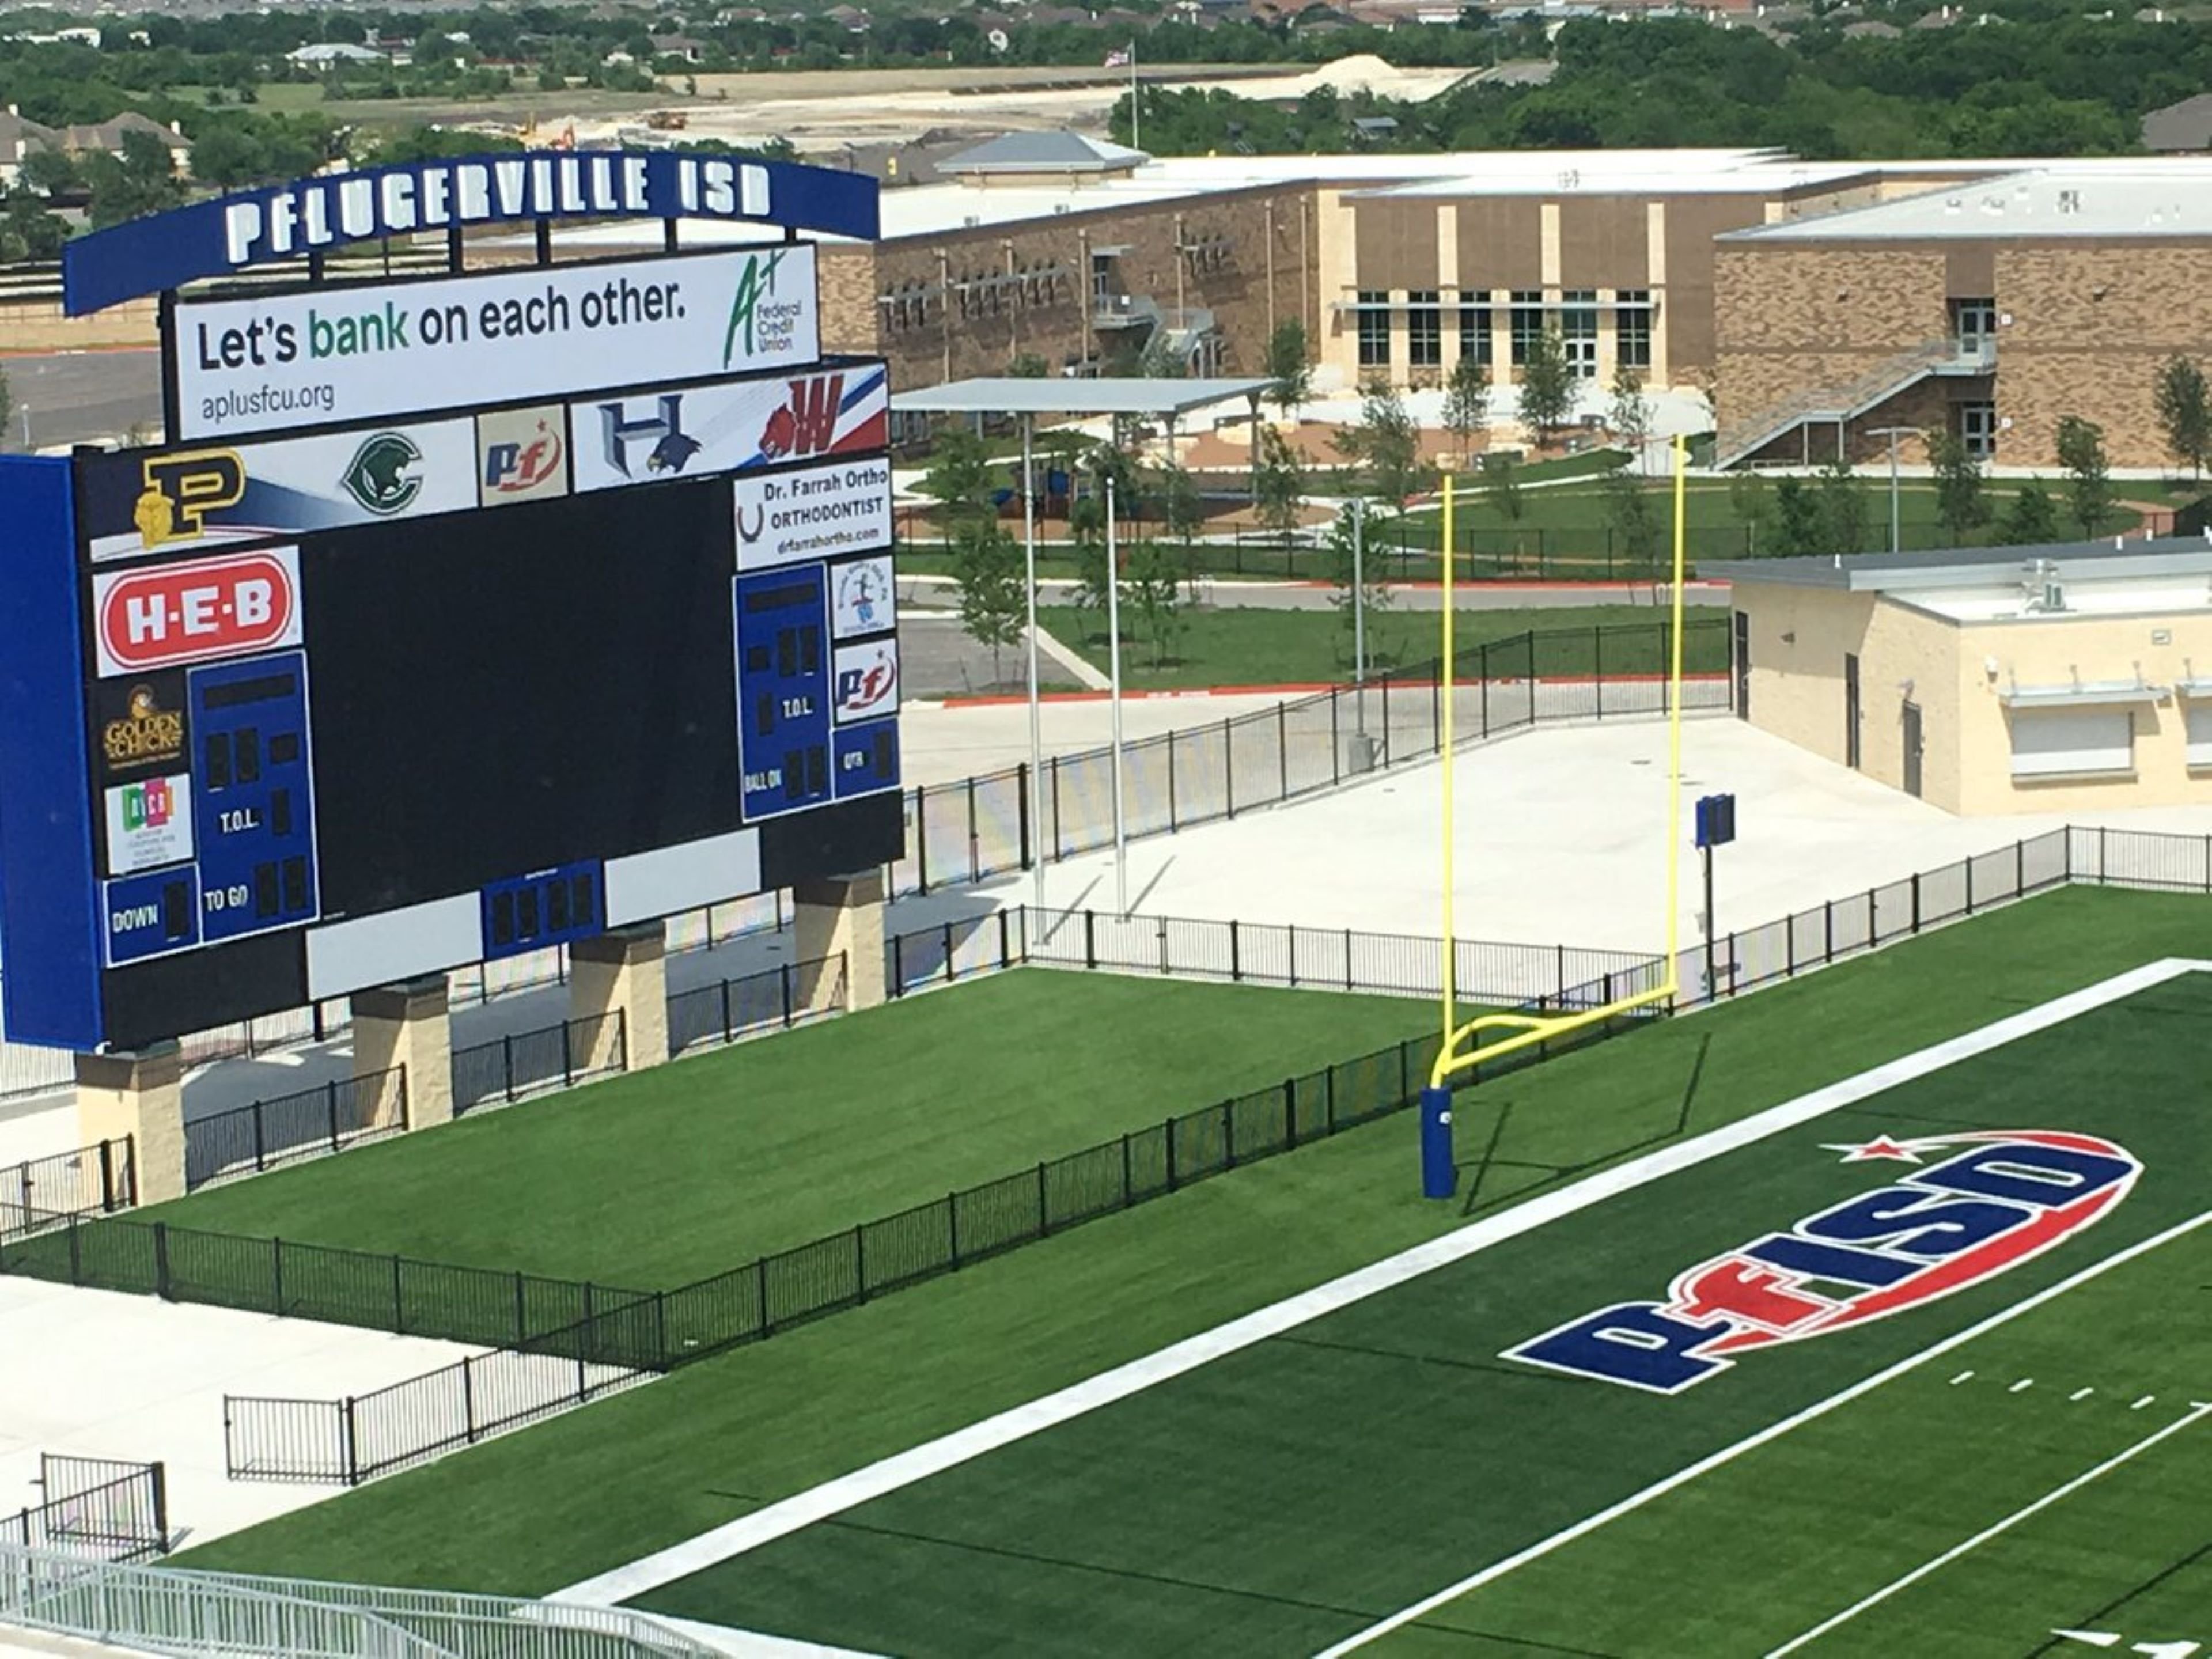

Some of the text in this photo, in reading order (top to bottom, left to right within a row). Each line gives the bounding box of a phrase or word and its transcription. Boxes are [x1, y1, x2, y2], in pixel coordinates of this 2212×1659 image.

[225, 157, 771, 264] PFLUGERVILLE ISD
[198, 278, 685, 370] Let's bank on each other.
[202, 382, 334, 425] aplusfcu.org
[764, 468, 888, 501] Dr. Farrah Ortho
[771, 497, 884, 529] ORTHODONTIST
[204, 885, 249, 912] TO GO
[112, 905, 158, 933] DOWN
